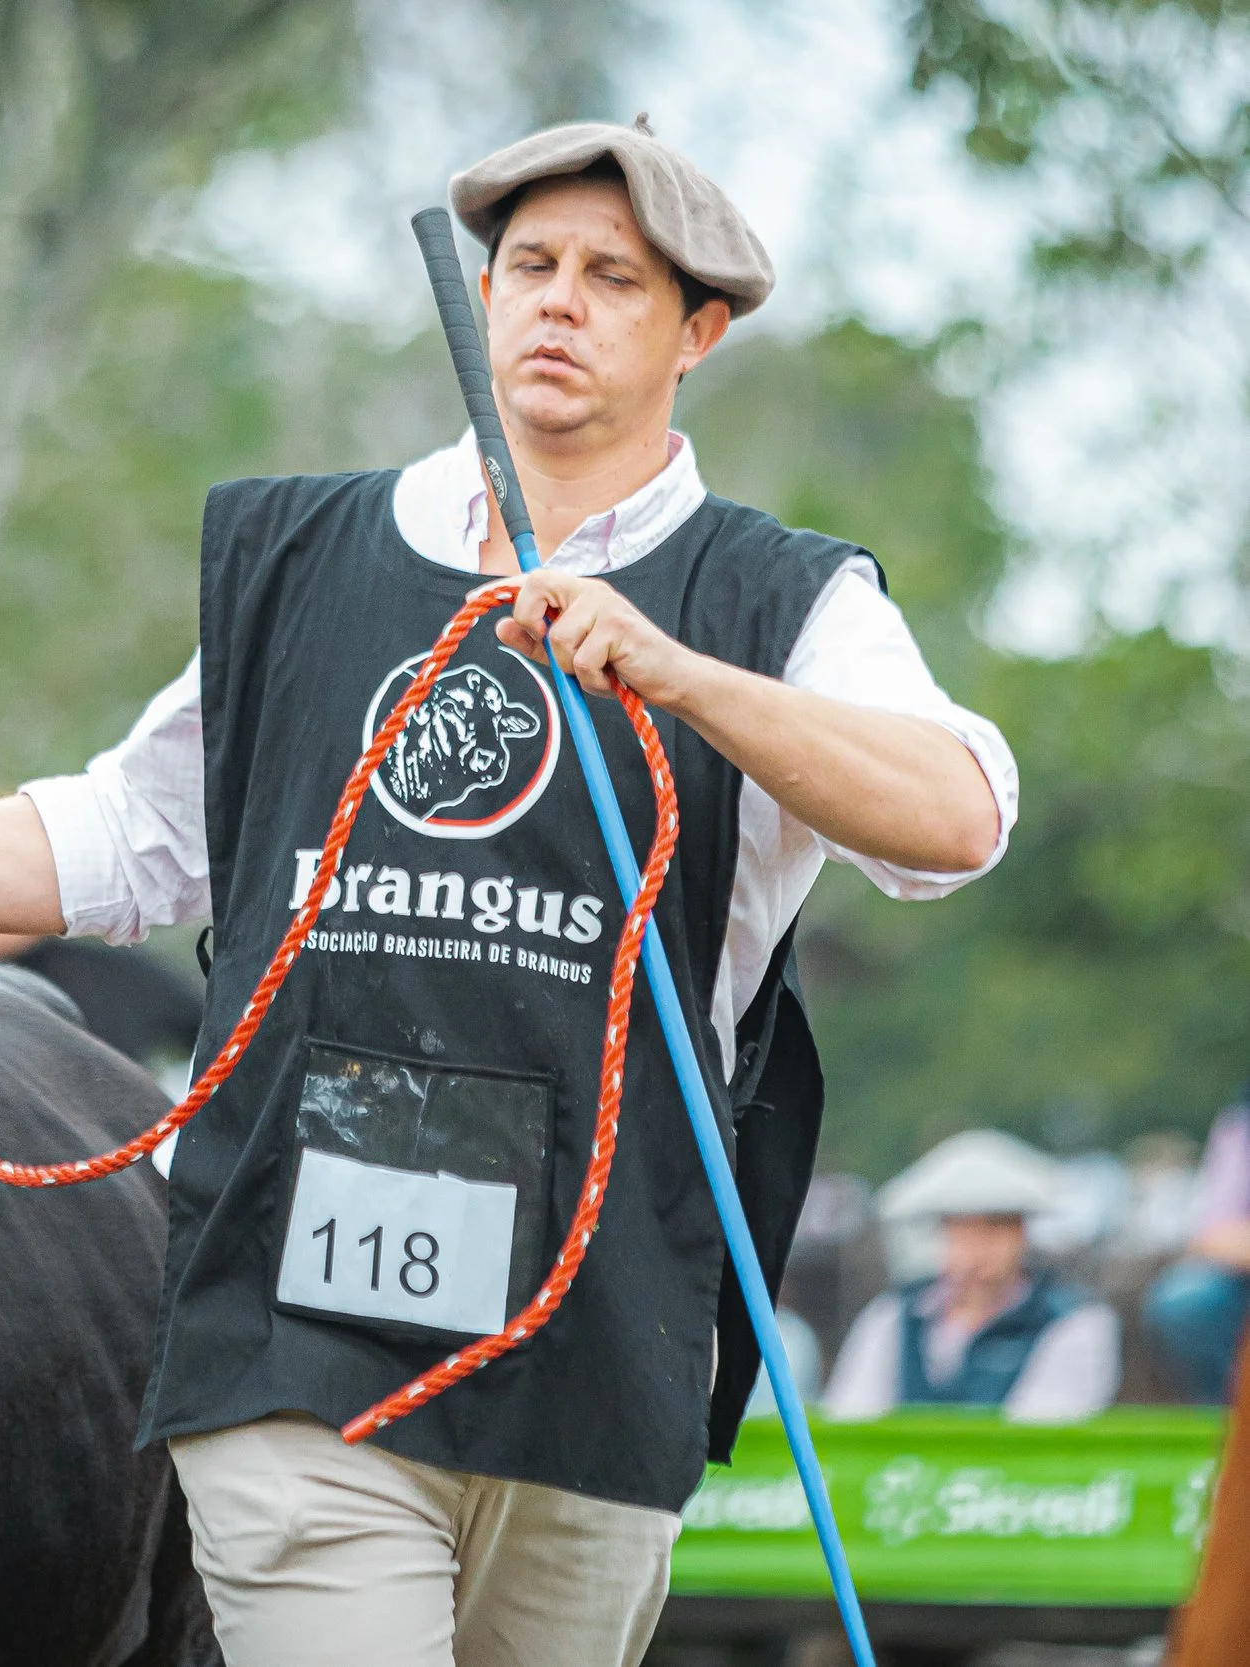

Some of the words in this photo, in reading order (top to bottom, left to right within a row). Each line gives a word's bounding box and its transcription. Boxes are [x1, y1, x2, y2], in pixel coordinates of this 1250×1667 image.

[289, 849, 604, 944] Brangus
[300, 929, 378, 955] SOCIAÇÃO
[383, 933, 481, 961] BRASILEIRA
[488, 942, 511, 964] DE
[516, 947, 593, 984] BRANGUS
[312, 1218, 440, 1299] 118
